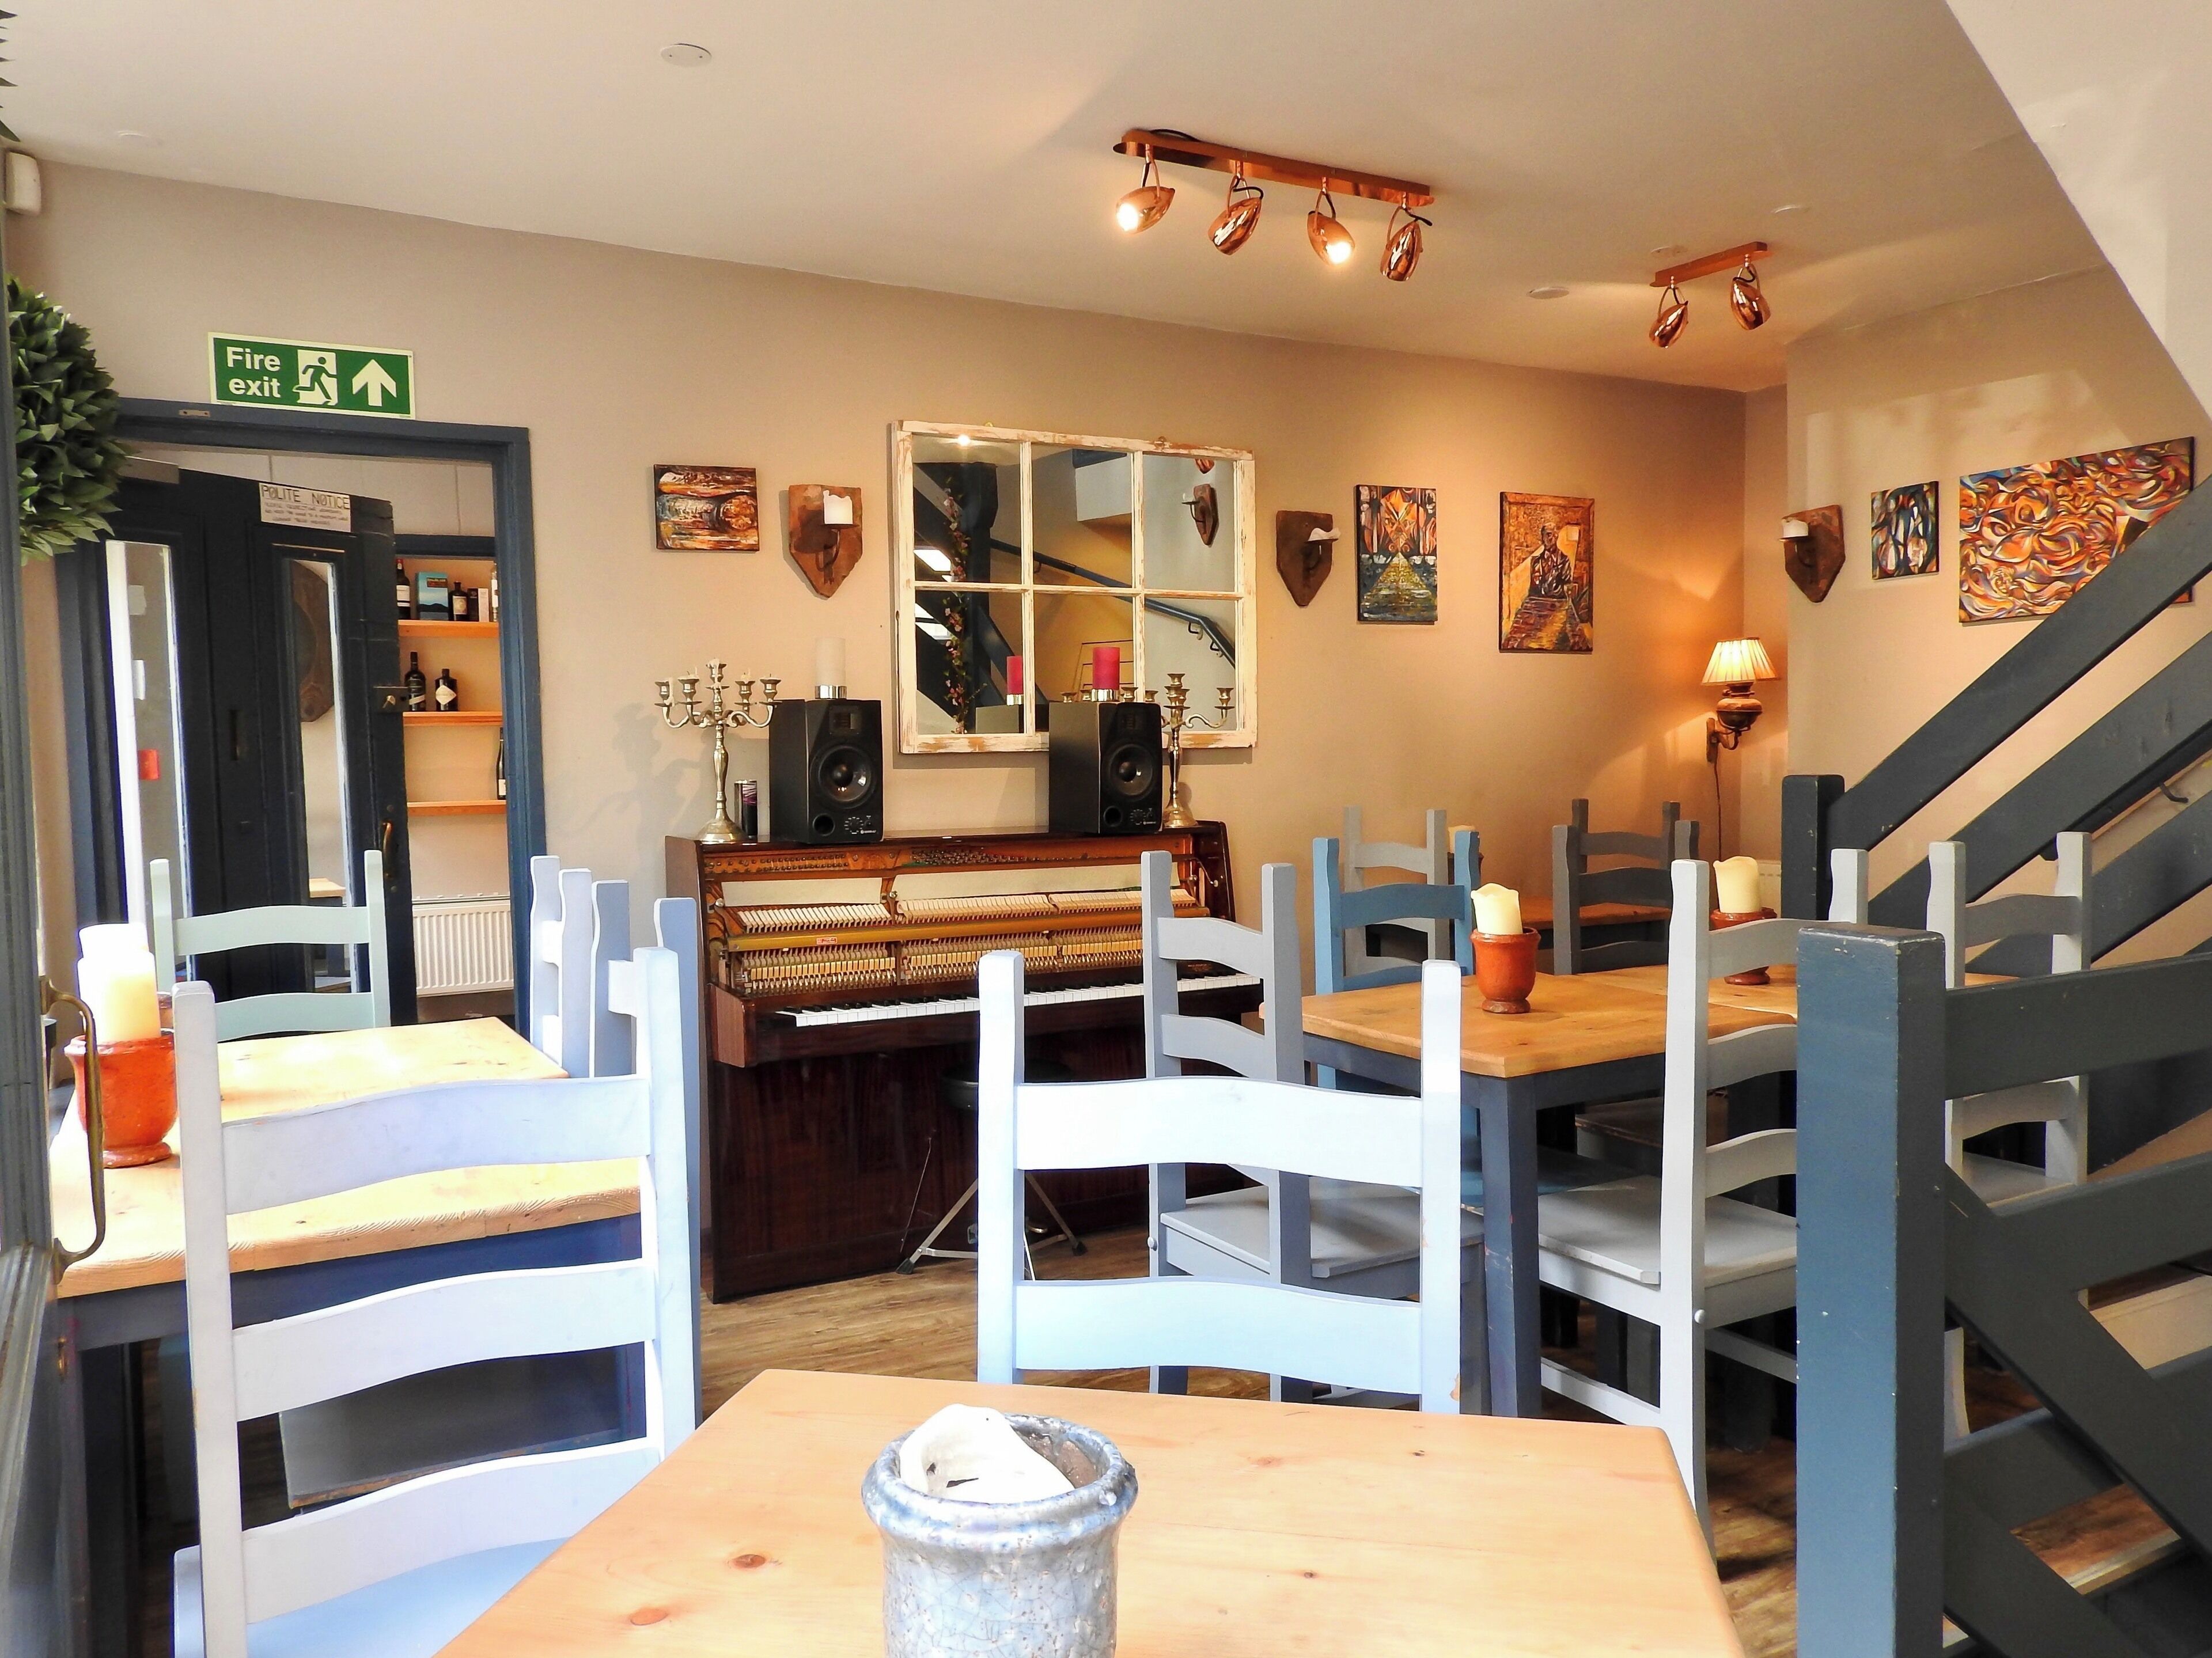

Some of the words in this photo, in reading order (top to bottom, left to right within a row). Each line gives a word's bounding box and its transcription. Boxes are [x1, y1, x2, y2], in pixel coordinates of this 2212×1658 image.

[226, 346, 281, 371] Fire
[229, 376, 281, 398] exit
[261, 485, 301, 502] POLITE
[312, 493, 350, 510] NOTICE
